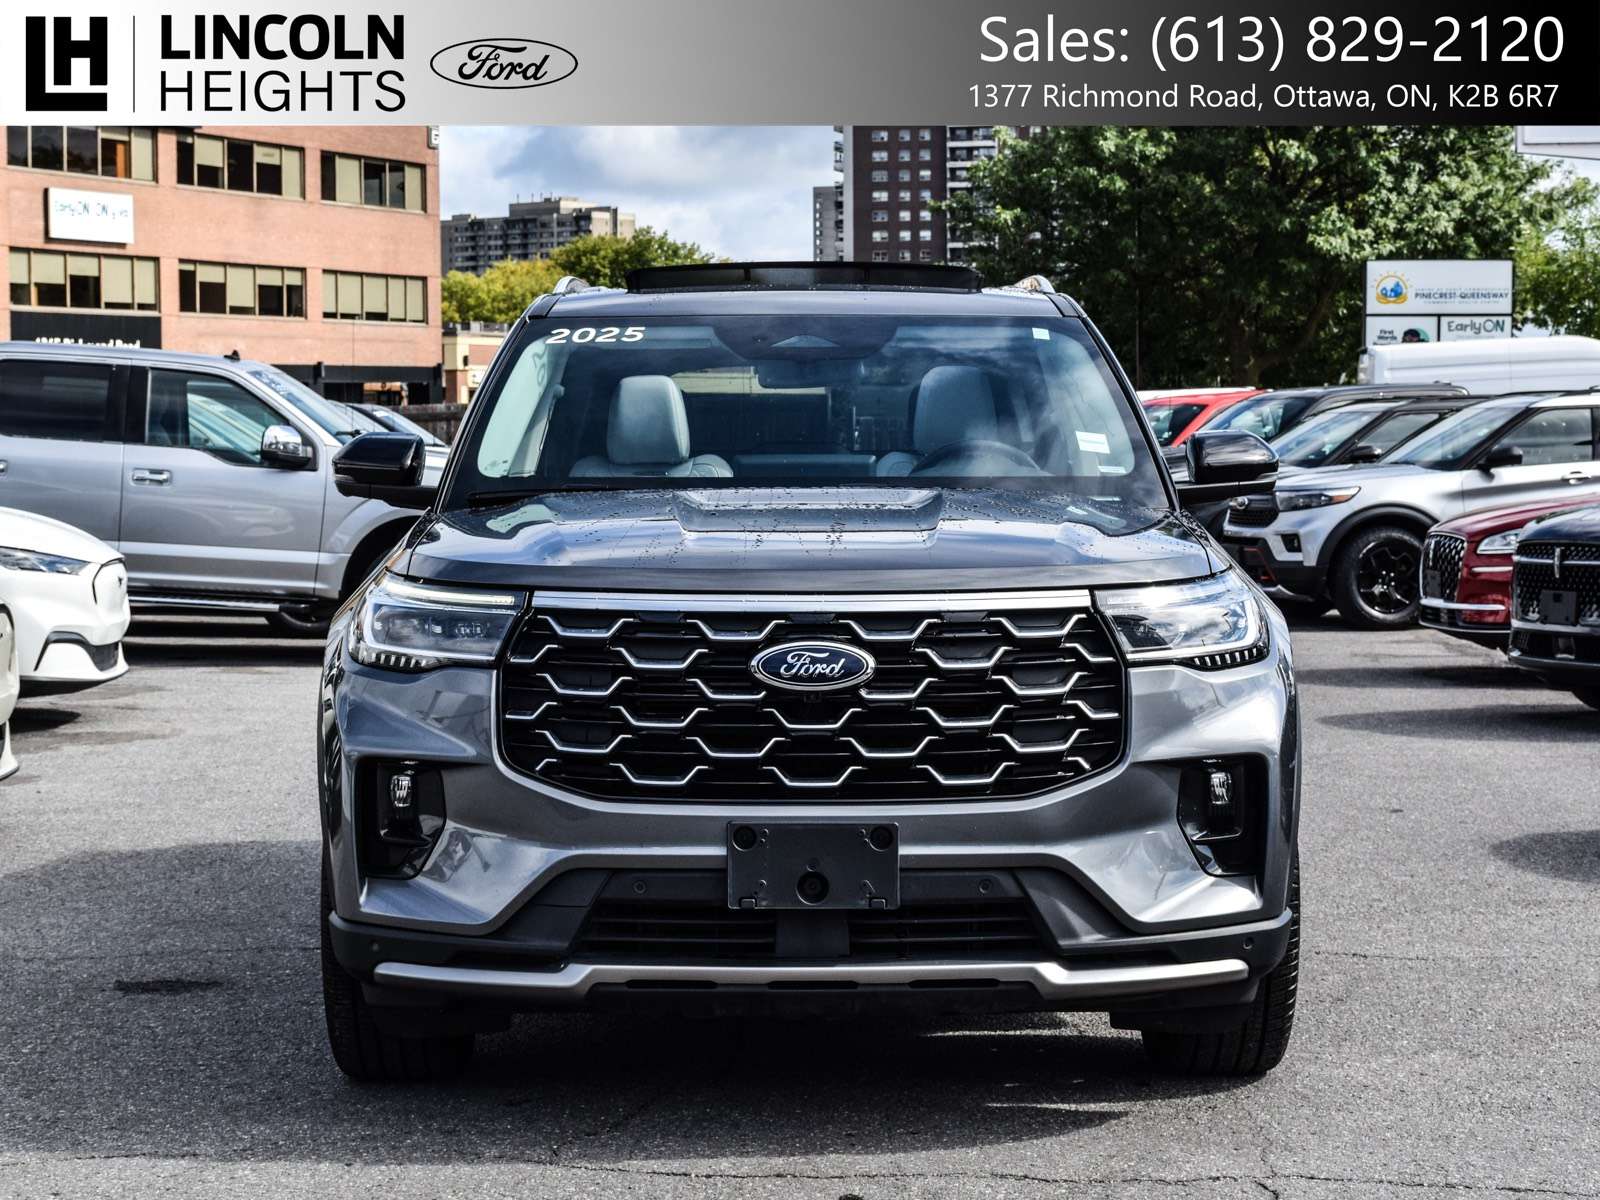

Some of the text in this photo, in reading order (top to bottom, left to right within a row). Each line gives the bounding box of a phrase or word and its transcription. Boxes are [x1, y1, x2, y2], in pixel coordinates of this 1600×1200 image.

[545, 326, 646, 344] 2025
[1447, 319, 1505, 335] EarlyON
[780, 651, 846, 678] Ford
